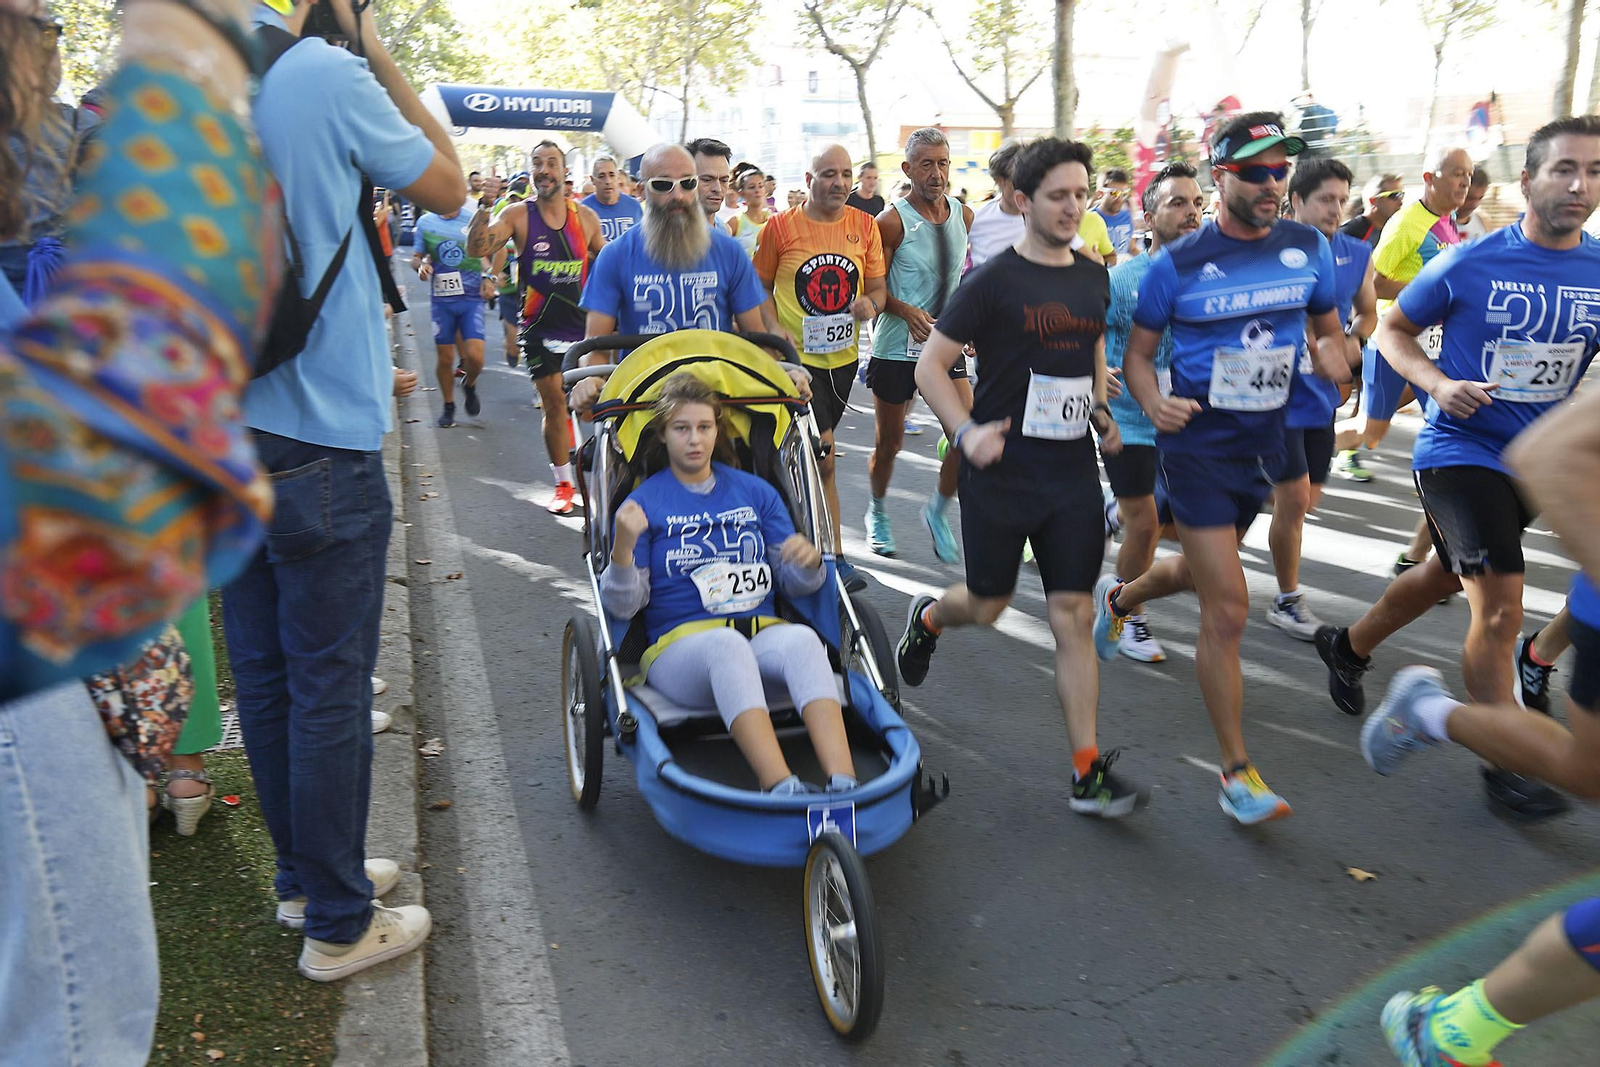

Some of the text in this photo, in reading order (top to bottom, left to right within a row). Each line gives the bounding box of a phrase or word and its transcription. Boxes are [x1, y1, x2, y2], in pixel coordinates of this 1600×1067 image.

[503, 96, 592, 114] HYUNDAI
[544, 116, 592, 128] SYRLUZ
[802, 254, 855, 275] SPARTAN
[442, 278, 461, 290] 751
[1491, 280, 1546, 294] VUELTA A
[826, 322, 853, 342] 528
[1530, 358, 1576, 385] 231
[1062, 394, 1091, 421] 678
[728, 567, 769, 595] 254
